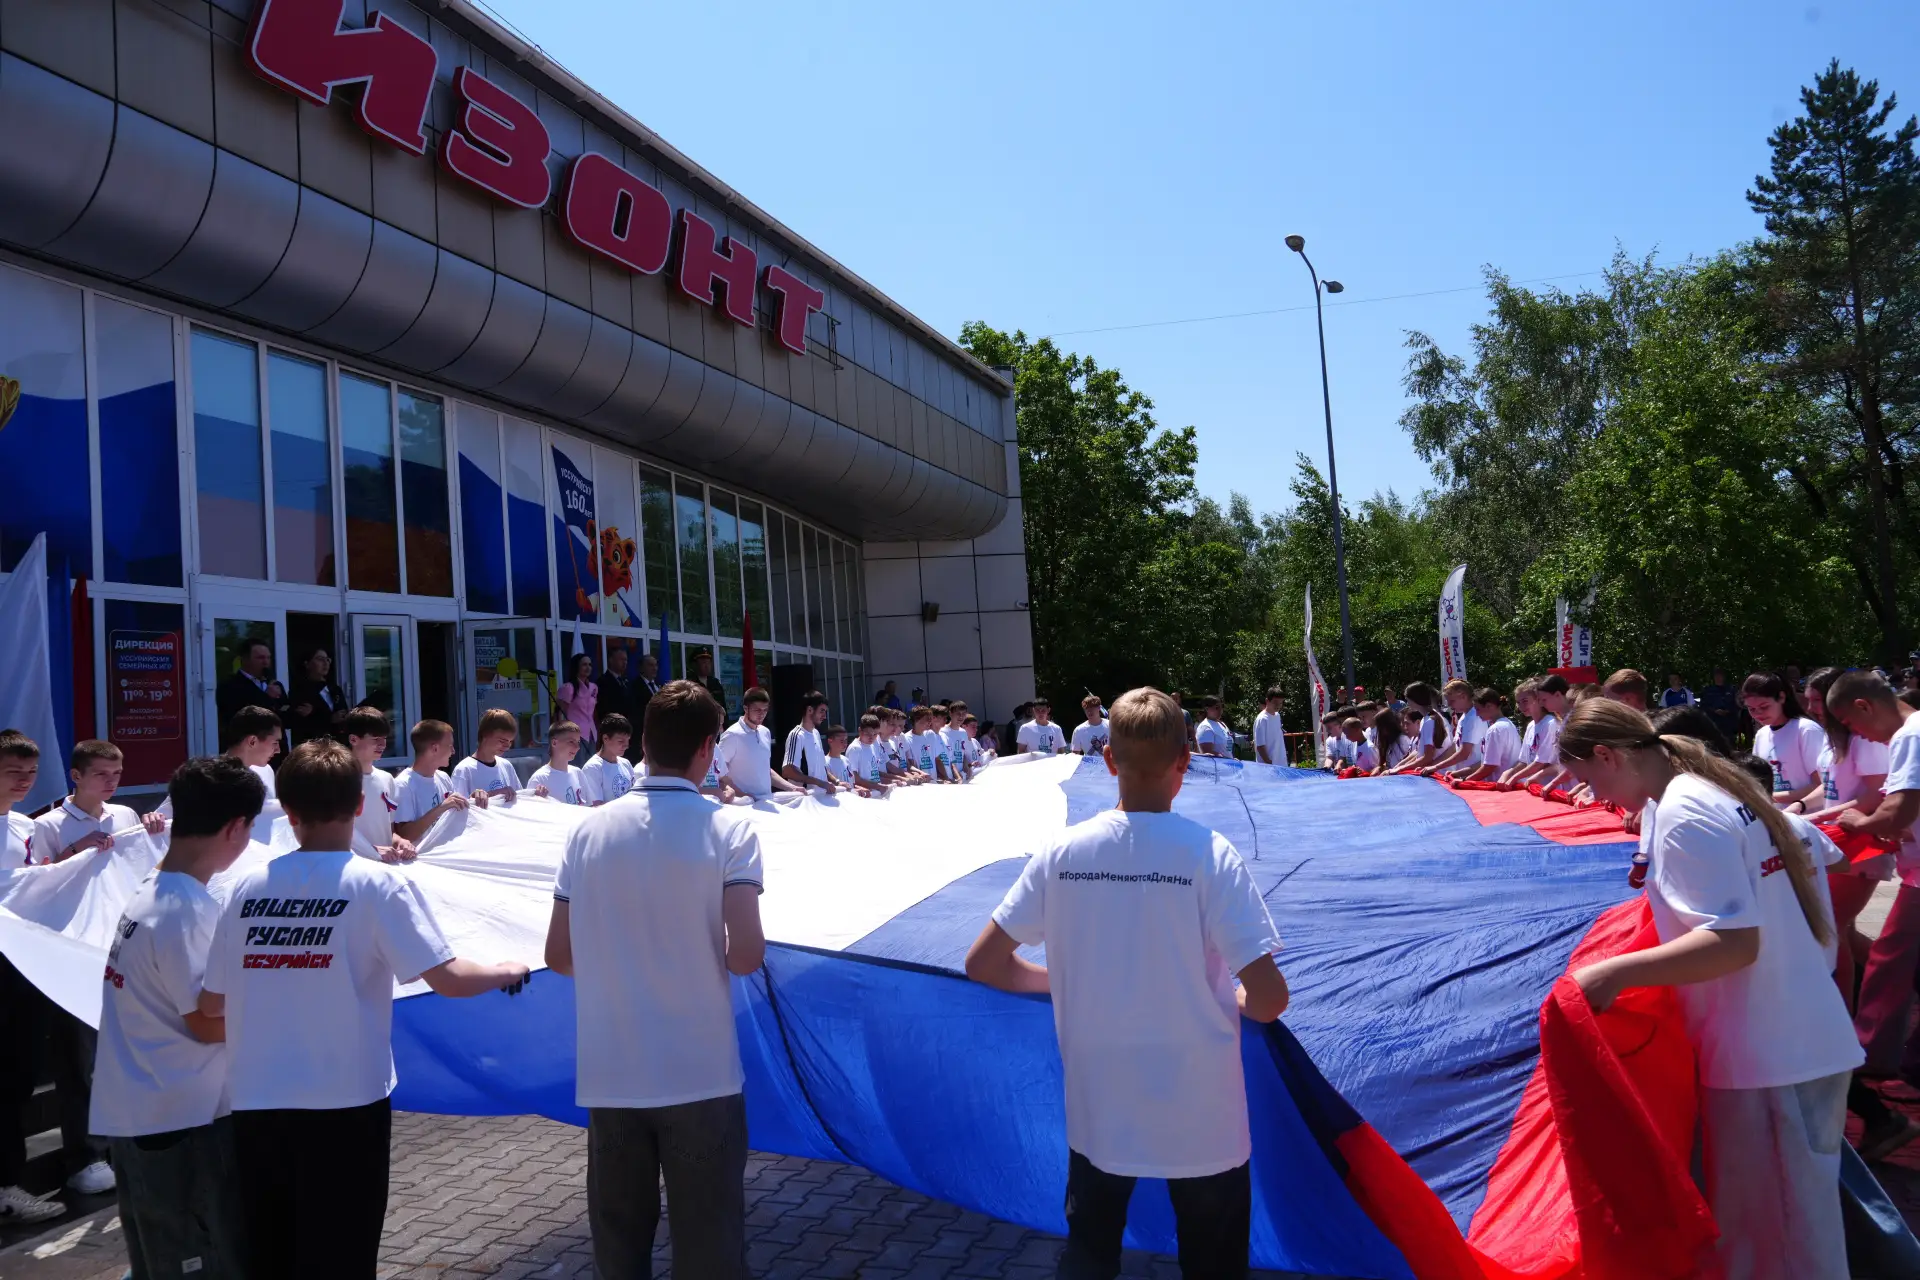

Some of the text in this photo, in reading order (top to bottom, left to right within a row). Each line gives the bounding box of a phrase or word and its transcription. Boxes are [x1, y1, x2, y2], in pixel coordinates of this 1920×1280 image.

[565, 489, 586, 513] 160
[114, 639, 174, 651] ДИРЕКЦИЯ
[1058, 871, 1193, 887] #ГородаМеняютсяДляНас
[245, 926, 334, 947] РУСЛАН
